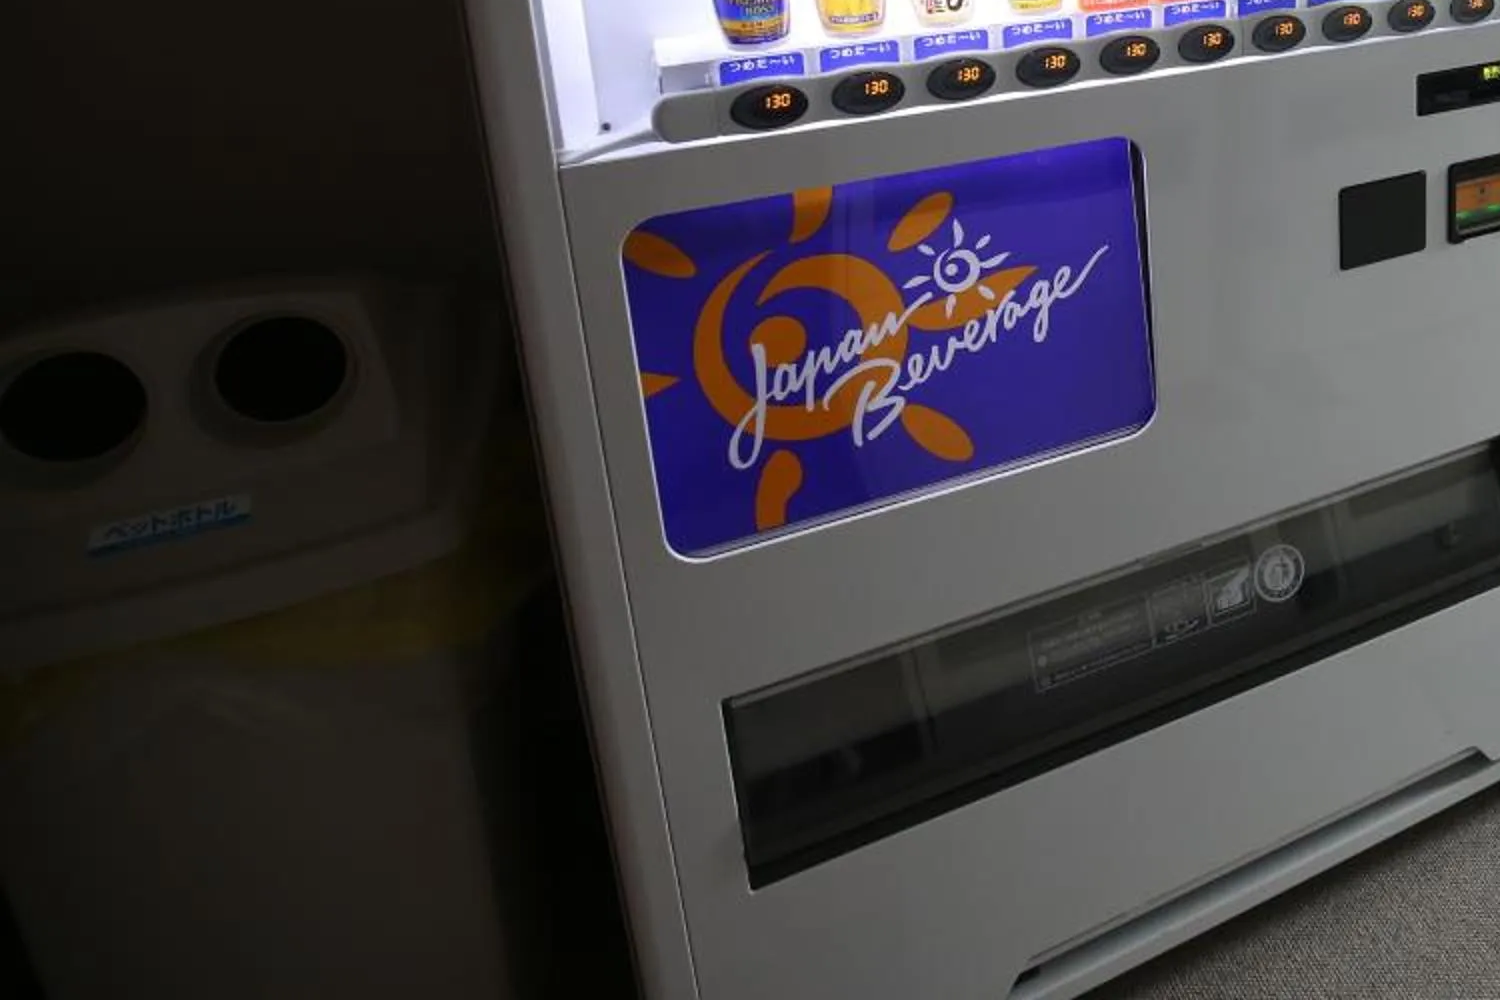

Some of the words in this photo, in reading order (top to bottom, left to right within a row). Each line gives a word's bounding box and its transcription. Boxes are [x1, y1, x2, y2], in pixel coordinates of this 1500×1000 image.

[1276, 22, 1293, 35] 130
[1204, 32, 1222, 46] 130
[1128, 44, 1146, 56] 130
[1046, 55, 1066, 68] 130
[958, 66, 980, 81] 130
[865, 80, 888, 95] 130
[766, 93, 790, 108] 130
[823, 245, 1111, 447] Beverage
[728, 292, 934, 470] Japan
